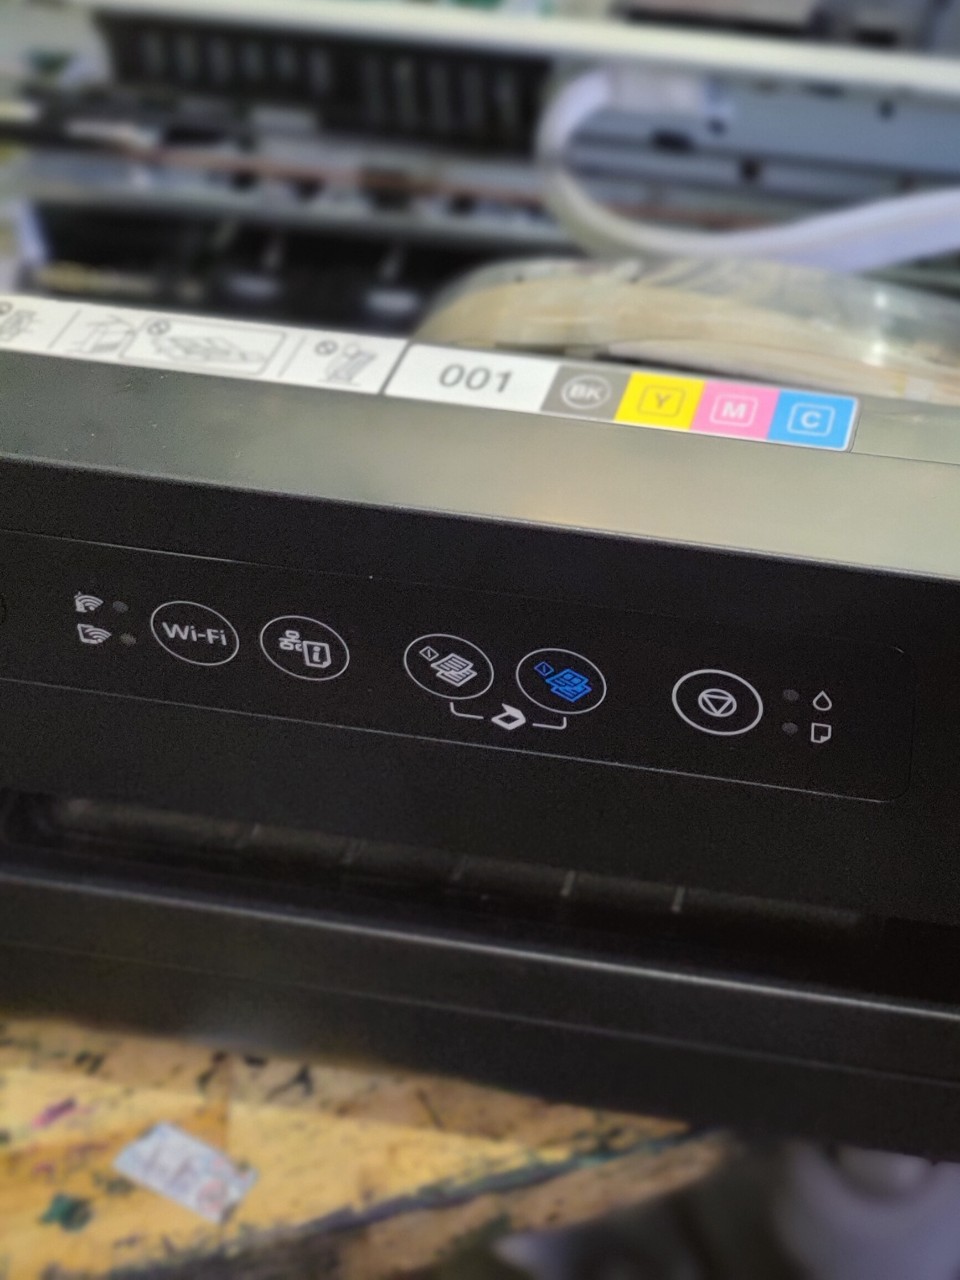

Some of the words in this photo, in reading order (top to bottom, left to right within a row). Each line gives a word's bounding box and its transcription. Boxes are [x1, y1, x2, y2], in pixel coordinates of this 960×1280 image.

[438, 362, 513, 394] 001
[566, 381, 604, 402] BK
[654, 393, 671, 410] Y
[721, 401, 747, 419] M
[801, 410, 821, 429] C
[162, 621, 228, 646] Wi-Fi
